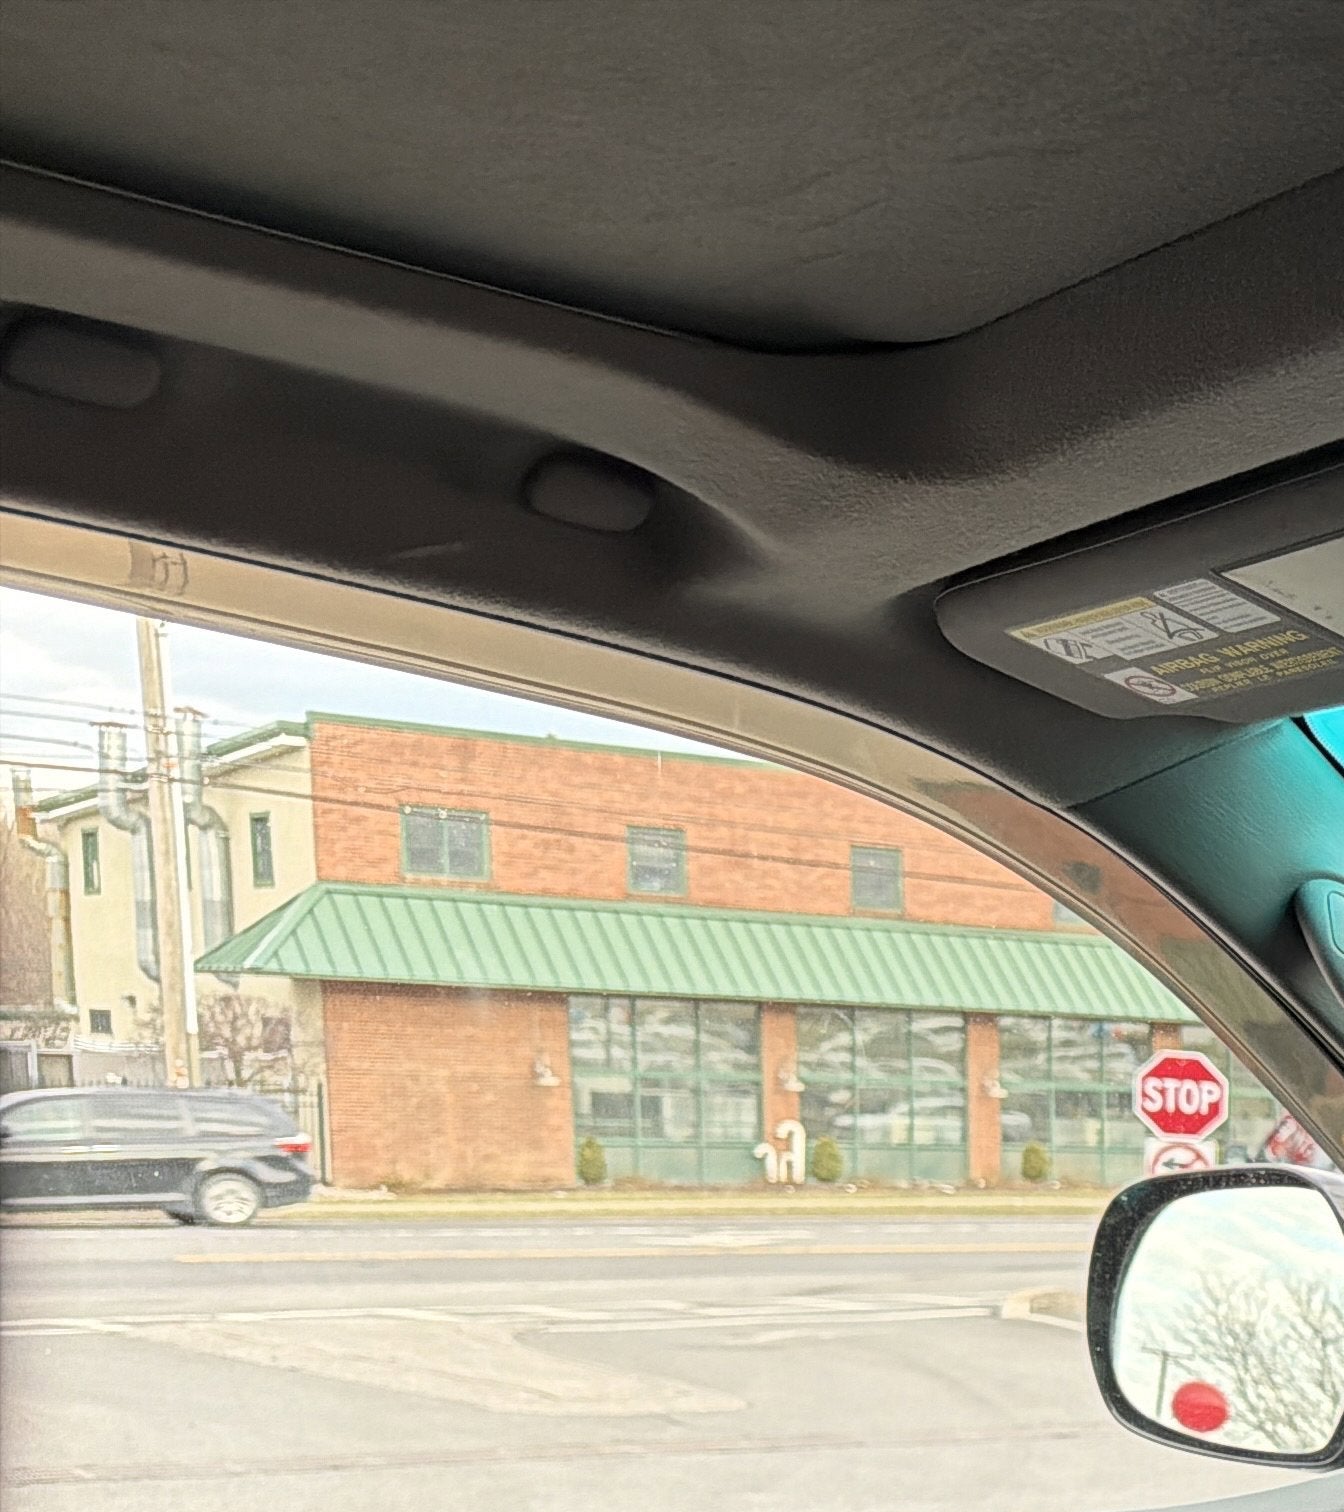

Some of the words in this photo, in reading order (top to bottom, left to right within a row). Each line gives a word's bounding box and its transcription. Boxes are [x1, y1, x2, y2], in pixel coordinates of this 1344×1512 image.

[1151, 653, 1220, 676] AIRBAG
[1217, 629, 1310, 659] WARNING
[1142, 1076, 1221, 1115] STOP
